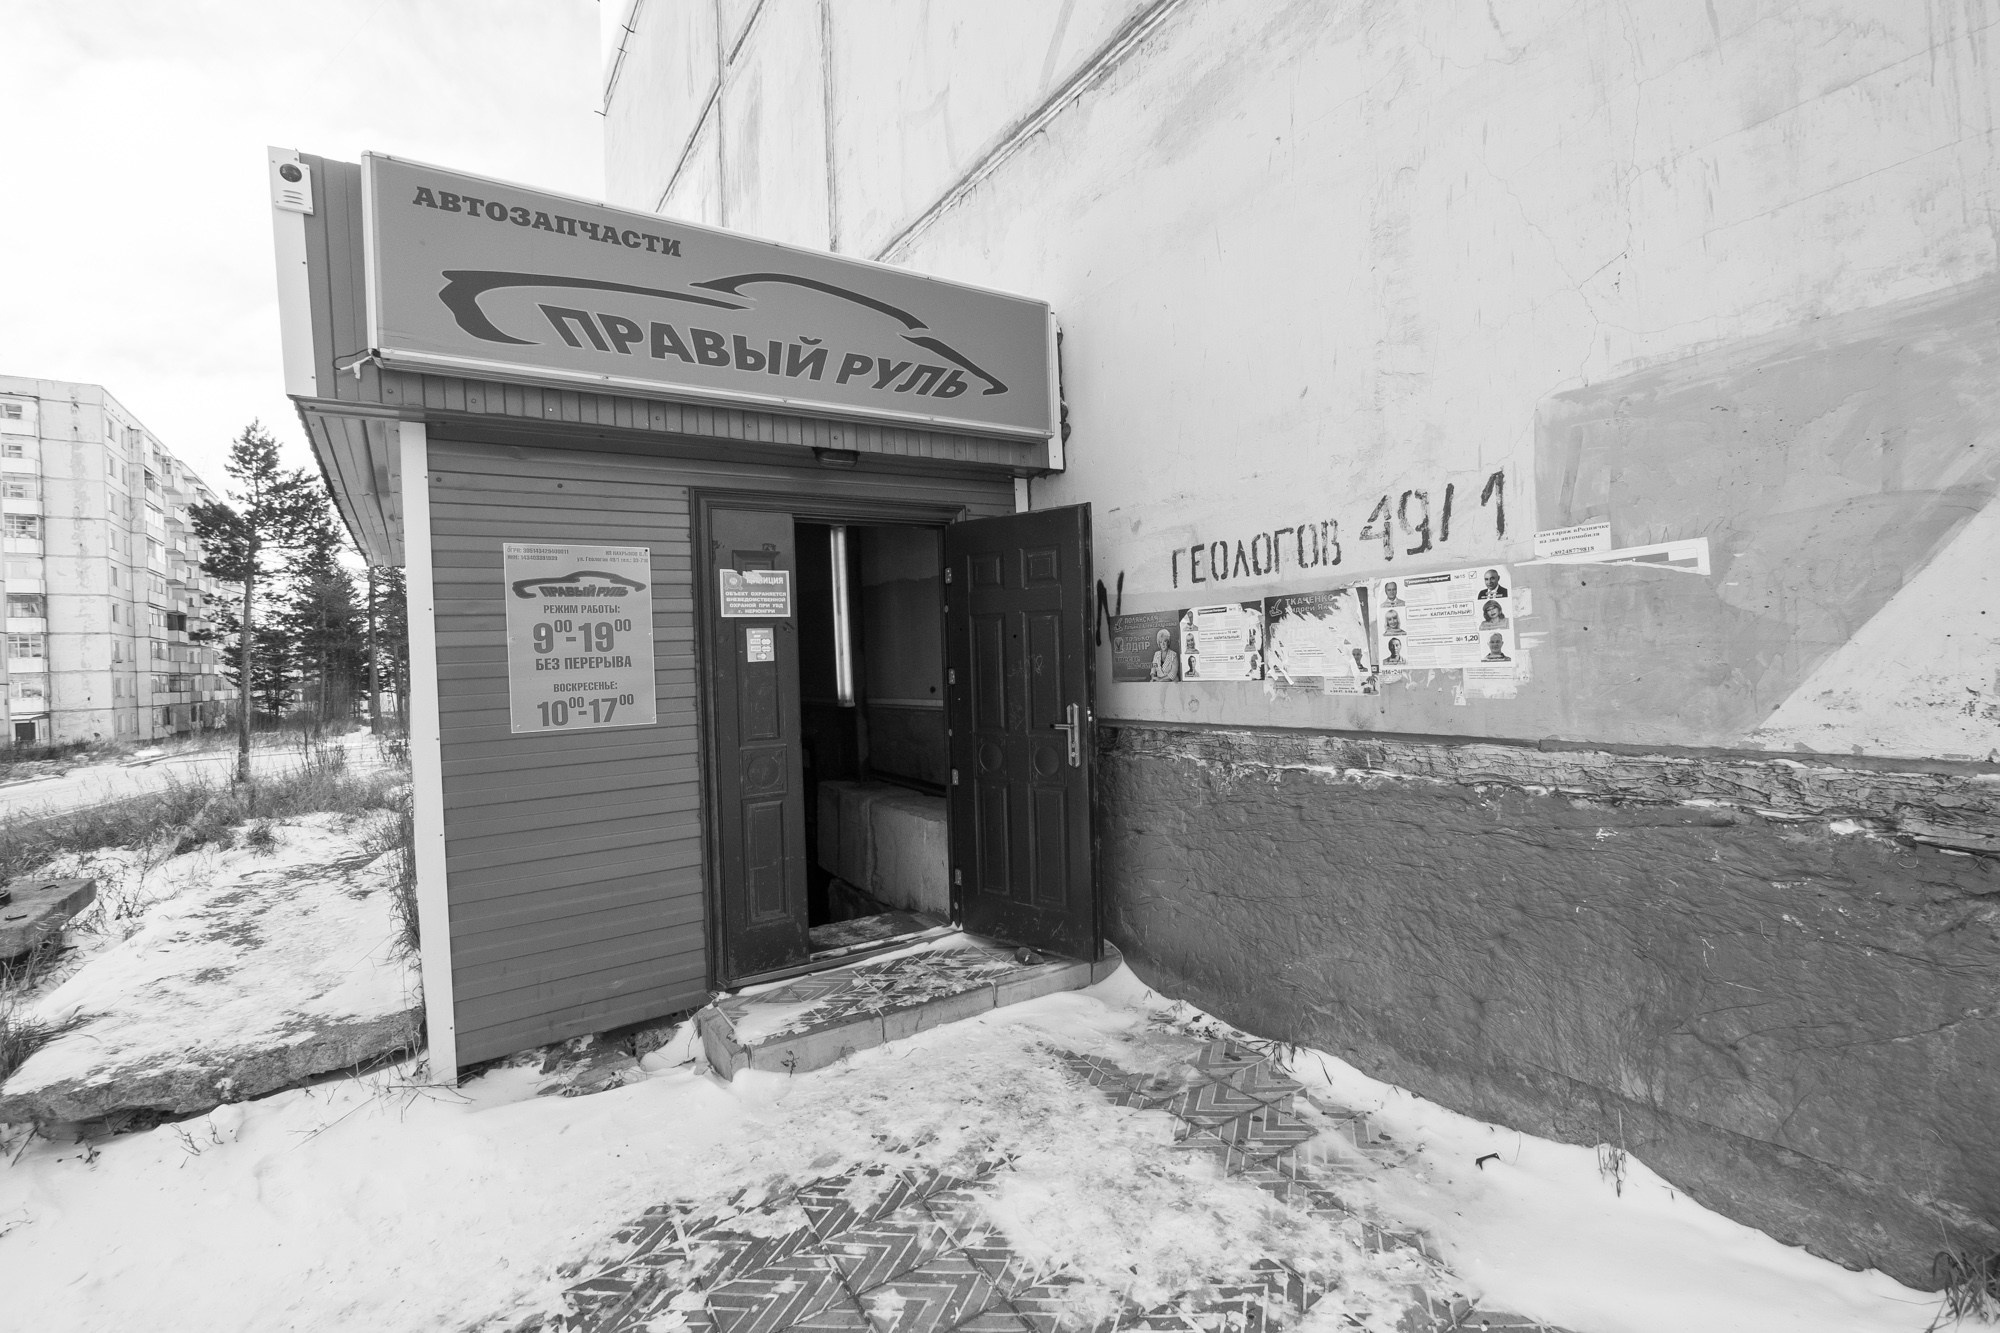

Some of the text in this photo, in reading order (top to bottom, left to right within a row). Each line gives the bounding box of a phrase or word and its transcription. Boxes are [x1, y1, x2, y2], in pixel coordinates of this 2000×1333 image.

[412, 186, 682, 258] АВТОЗАПЧАСТИ
[537, 303, 969, 399] ПРАВЫЙ РУЛЬ
[1171, 518, 1342, 589] ГЕОЛОГОВ
[537, 584, 629, 598] ПРАВЫЙ РУЛЬ
[1285, 594, 1334, 606] ТКАЧЕНКО
[543, 604, 621, 614] РЕЖИМ РАБОТЫ:
[1463, 634, 1479, 642] 1,20
[1125, 641, 1151, 653] ЛДПР
[535, 656, 632, 671] БЕЗ ПЕРЕРЫВА
[553, 681, 618, 693] ВОСКРЕСЕНЬЕ:
